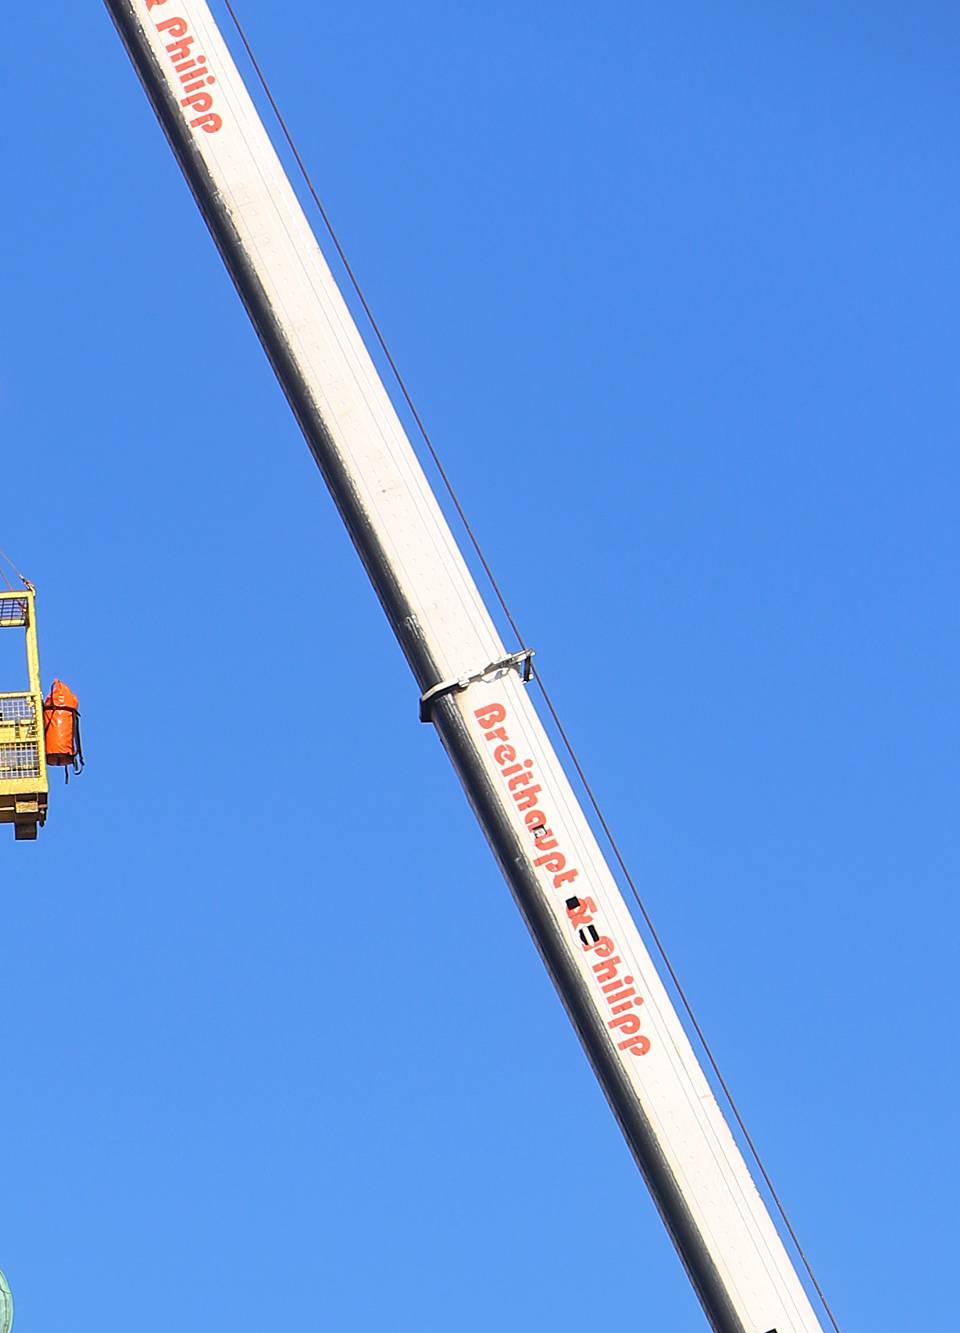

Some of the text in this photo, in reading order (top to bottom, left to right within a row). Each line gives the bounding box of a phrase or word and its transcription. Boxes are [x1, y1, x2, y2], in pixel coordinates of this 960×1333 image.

[156, 17, 223, 133] Philipp
[473, 703, 579, 888] Breithaupt
[581, 935, 651, 1056] Philipp
